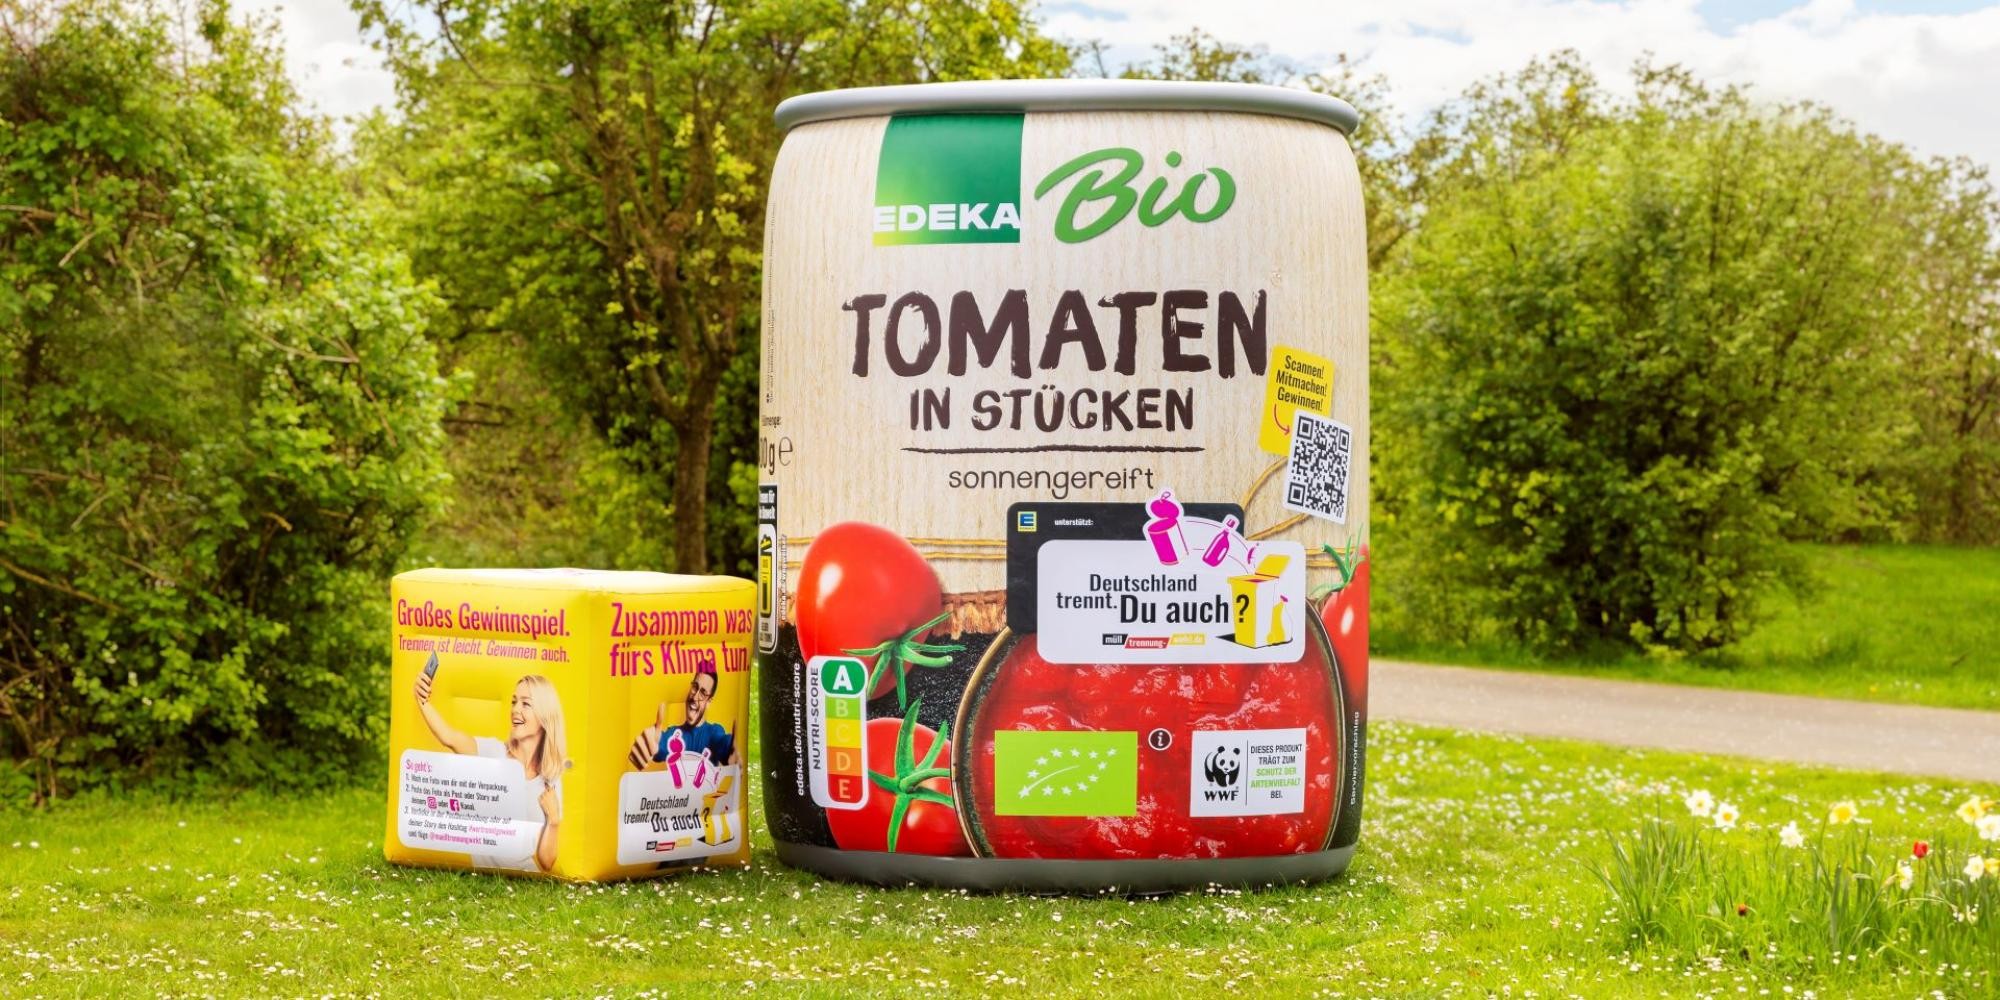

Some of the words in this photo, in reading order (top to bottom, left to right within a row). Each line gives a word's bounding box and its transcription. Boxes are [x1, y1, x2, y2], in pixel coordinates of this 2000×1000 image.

[1034, 147, 1237, 245] Bio
[874, 203, 1021, 232] EDEKA
[842, 288, 1268, 379] TOMATEN
[1284, 354, 1325, 380] Scannen!
[1276, 369, 1327, 397] Mitmachen!
[909, 387, 950, 431] IN
[971, 384, 1194, 432] STÜCKEN
[1277, 386, 1324, 412] Gewinnen!
[948, 468, 1154, 500] sonnengereift
[1089, 573, 1198, 592] Deutschland
[397, 598, 453, 629] Großes
[458, 602, 571, 640] Gewinnspiel.
[610, 602, 719, 637] Zusammen
[724, 609, 752, 634] was
[1056, 592, 1118, 610] trennt.
[1120, 594, 1156, 624] Du
[1166, 593, 1230, 624] auch
[398, 634, 435, 651] Trennen
[437, 636, 450, 653] ist
[453, 637, 483, 656] leicht.
[486, 640, 538, 660] Gewinnen
[541, 646, 571, 663] auch.
[1105, 634, 1123, 644] müll
[609, 642, 655, 677] fürs
[660, 639, 717, 675] Klima
[721, 640, 750, 673] tun.
[832, 665, 853, 691] A
[810, 667, 821, 770] NUTRI-SCORE
[835, 699, 849, 717] B
[794, 663, 804, 796] edeka.de/nutri-score
[836, 725, 850, 743] C
[836, 752, 851, 771] D
[1250, 745, 1274, 754] DIESES
[1275, 744, 1302, 753] PRODUKT
[1258, 755, 1281, 765] TRÄGT
[1282, 755, 1296, 764] ZUM
[1256, 767, 1283, 777] SCHUTZ
[476, 792, 490, 803] Story
[639, 793, 690, 811] Deutschland
[838, 779, 851, 799] E
[1204, 790, 1239, 802] WWF
[623, 811, 650, 824] trennt.
[650, 811, 670, 833] Du
[670, 808, 702, 832] auch
